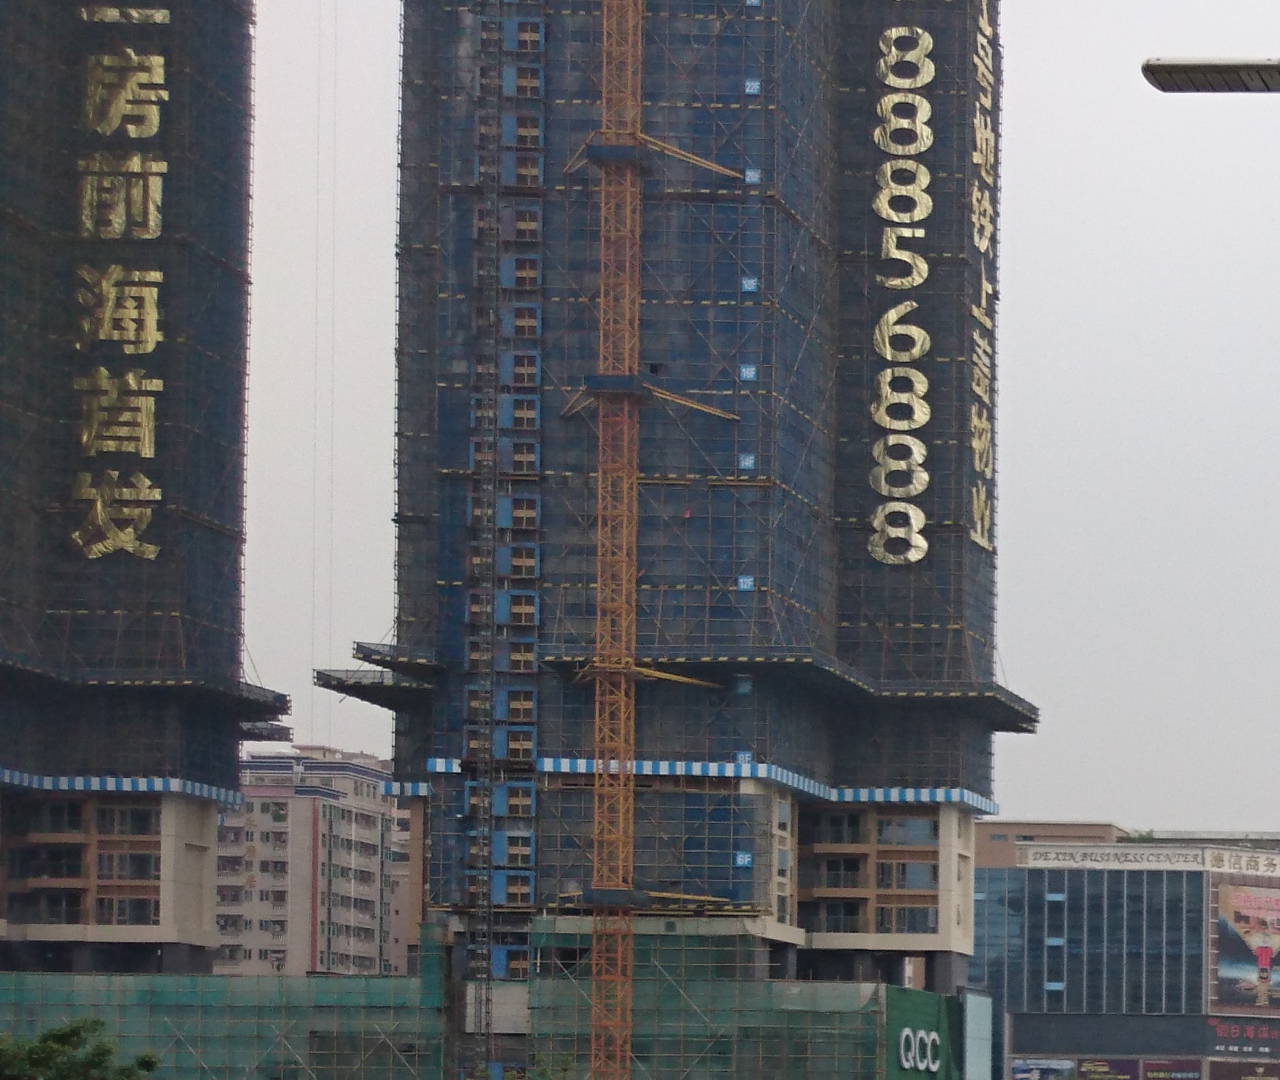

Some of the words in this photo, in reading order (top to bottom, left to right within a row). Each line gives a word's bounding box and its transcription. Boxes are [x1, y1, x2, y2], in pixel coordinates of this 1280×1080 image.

[745, 81, 760, 93] 22F
[72, 8, 170, 560] 房前海首发
[867, 26, 937, 566] 88856888
[1080, 851, 1145, 864] BUSINESS
[1146, 852, 1202, 865] CENTER
[900, 1027, 940, 1072] QCC
